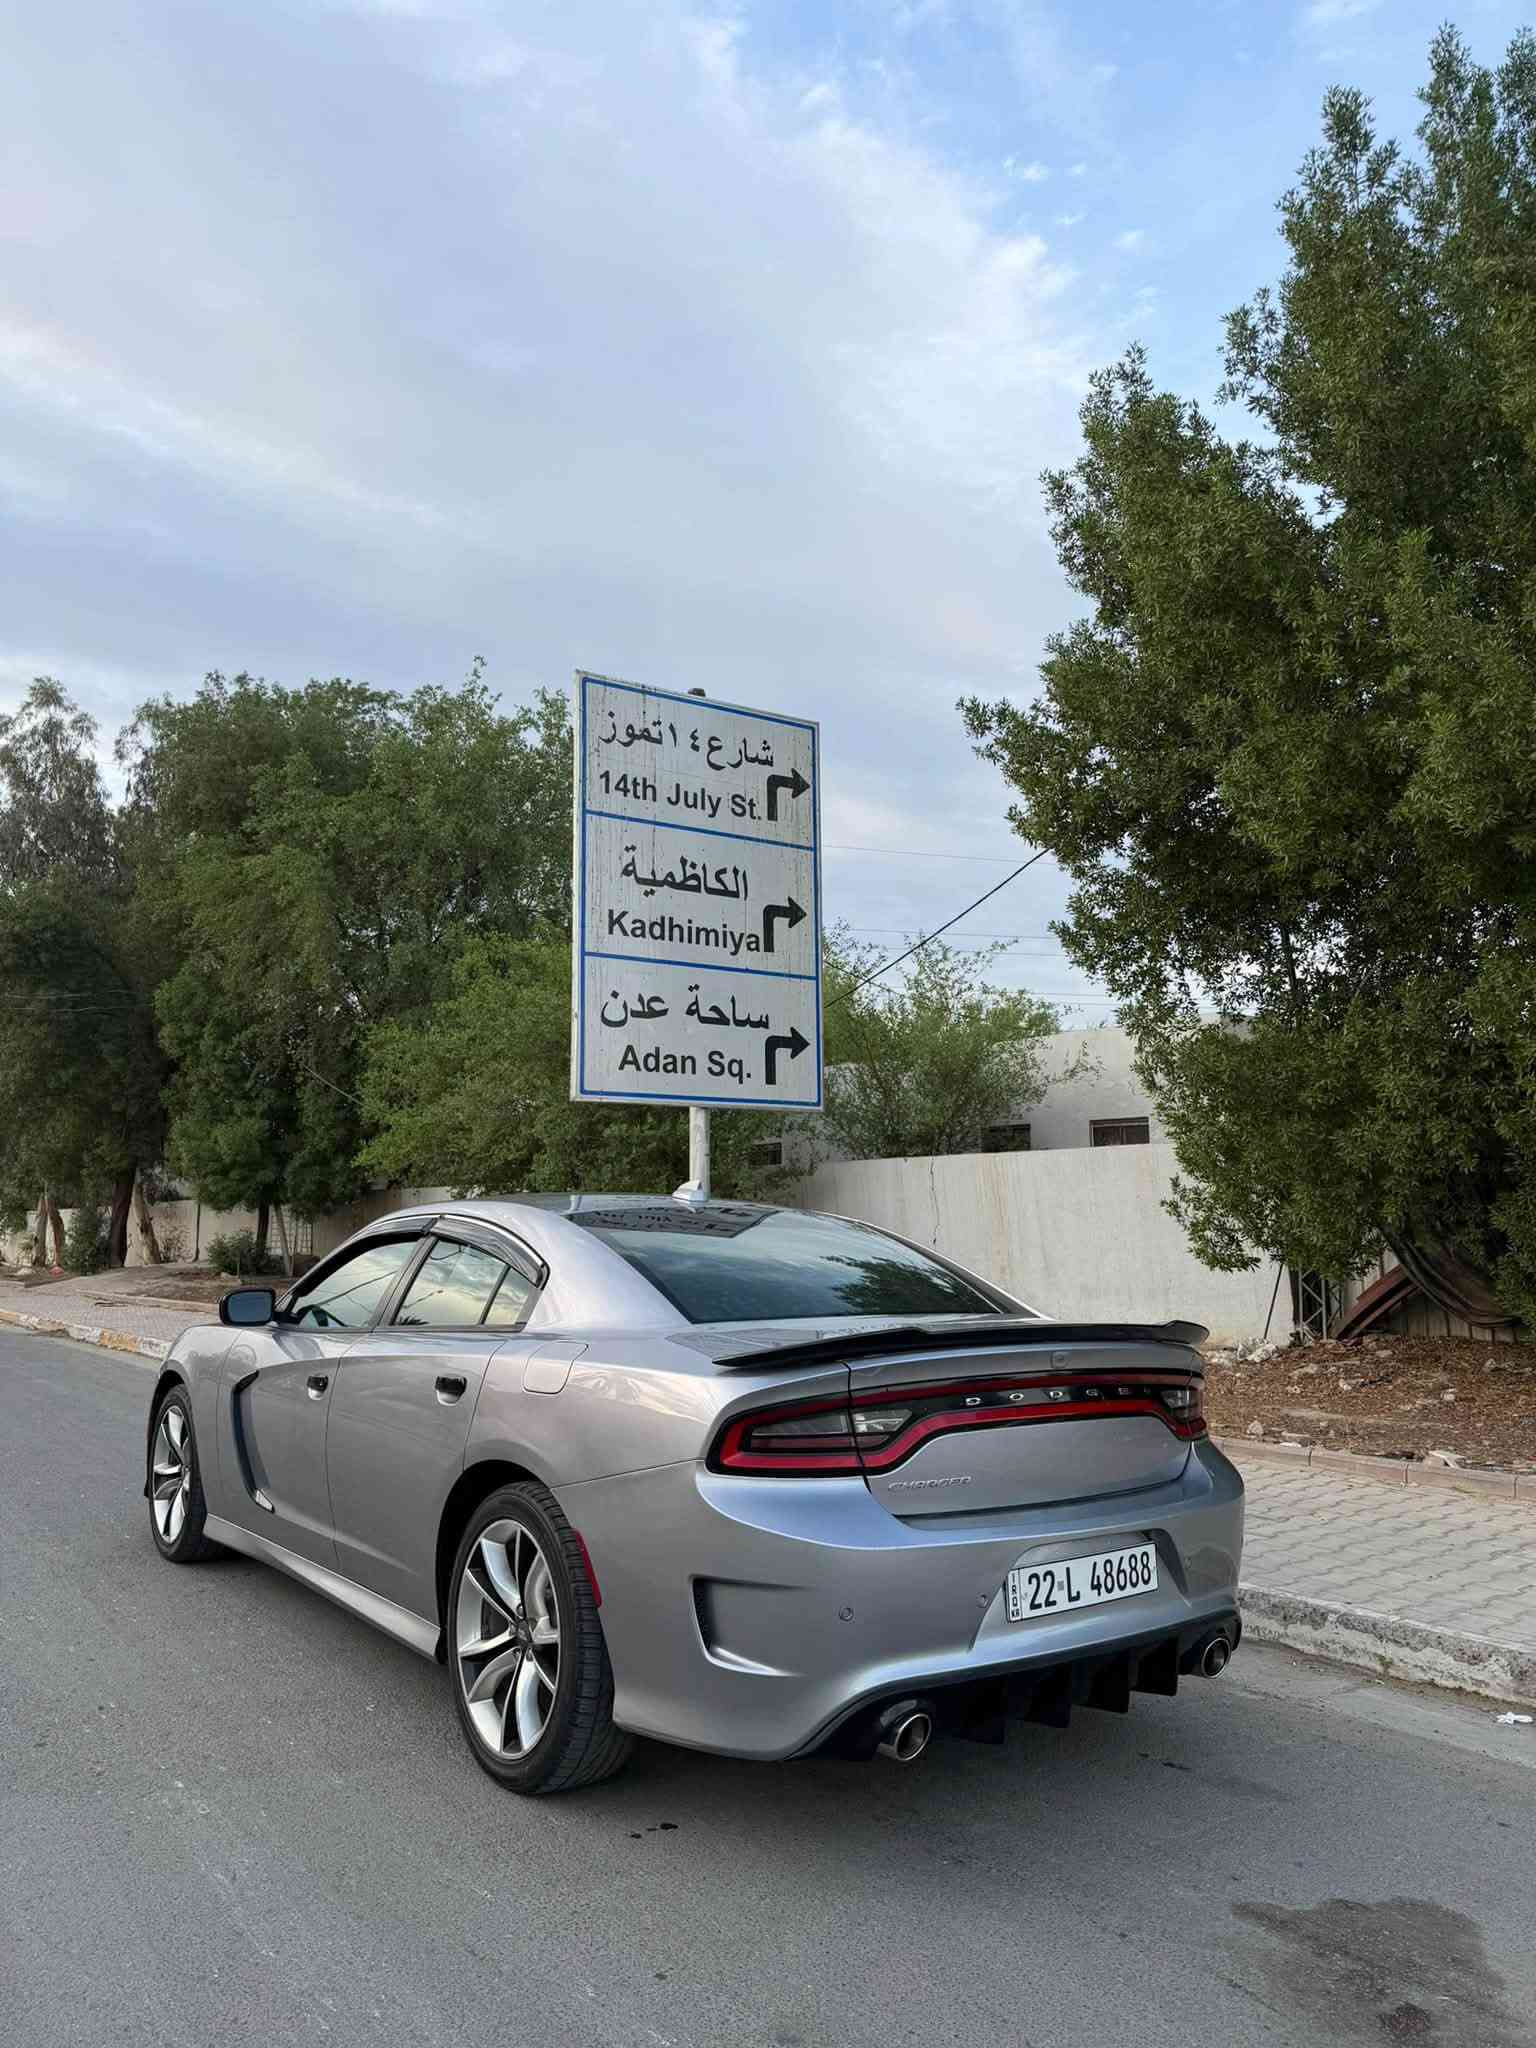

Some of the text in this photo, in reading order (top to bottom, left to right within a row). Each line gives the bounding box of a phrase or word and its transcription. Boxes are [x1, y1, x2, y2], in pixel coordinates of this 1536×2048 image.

[598, 711, 663, 747] تموز
[706, 736, 774, 771] شارع
[600, 770, 762, 820] 14th July St.
[621, 844, 748, 900] الكاظمية
[607, 909, 761, 956] Kadhimiya
[601, 983, 770, 1030] ساحة عدن
[618, 1044, 752, 1084] Adan Sq.
[965, 1387, 1130, 1406] DODGE
[1028, 1551, 1152, 1610] 22 L 48688
